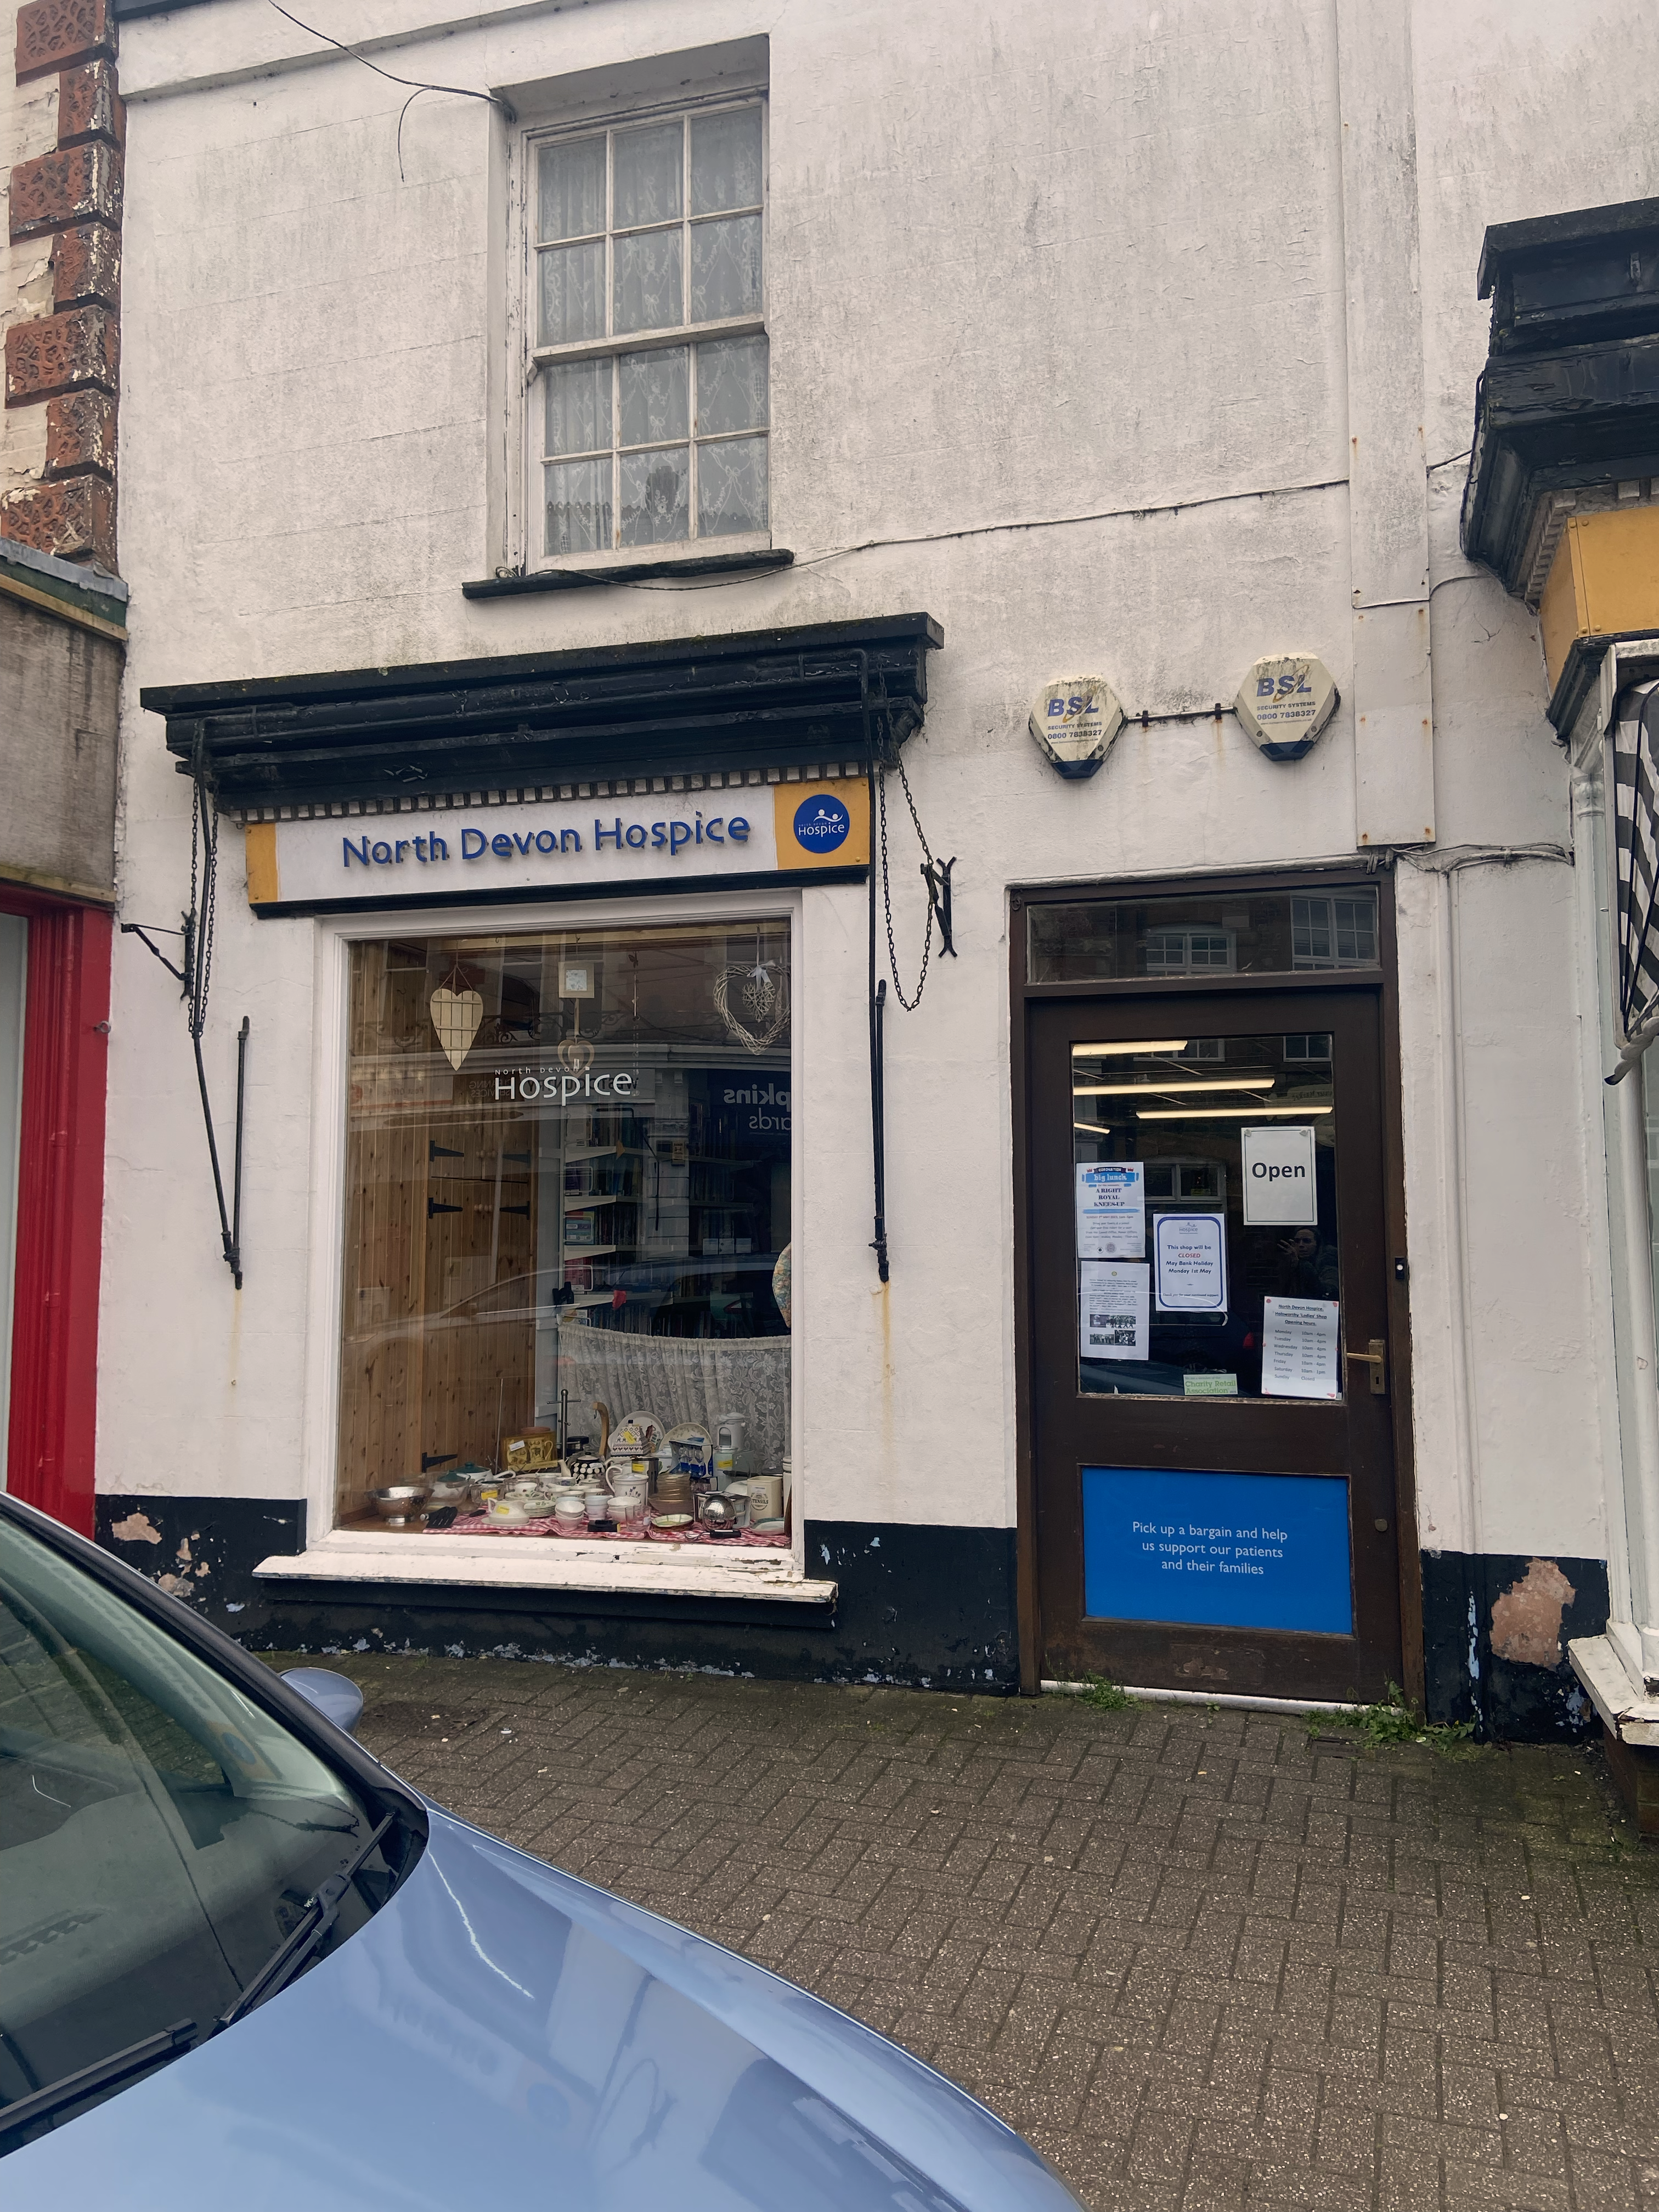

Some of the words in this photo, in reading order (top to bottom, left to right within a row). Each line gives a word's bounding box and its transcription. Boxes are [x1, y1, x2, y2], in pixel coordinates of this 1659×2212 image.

[1256, 674, 1312, 697] BSL
[1047, 695, 1099, 717] BSL
[1280, 710, 1316, 719] 7838327
[1069, 730, 1102, 738] 7838327
[343, 831, 449, 867] North
[461, 828, 580, 860] Devon
[595, 811, 751, 856] Hospice
[798, 822, 845, 838] Hospice
[495, 1066, 632, 1107] Hospice
[1252, 1162, 1305, 1182] Open
[1132, 1521, 1157, 1533] Pick
[1160, 1526, 1175, 1537] up
[1189, 1524, 1232, 1539] bargain
[1236, 1527, 1257, 1538] and
[1262, 1528, 1288, 1543] help
[1142, 1542, 1155, 1551] us
[1159, 1543, 1206, 1555] support
[1209, 1545, 1231, 1555] our
[1235, 1546, 1283, 1559] patients
[1161, 1559, 1183, 1570] and
[1186, 1560, 1216, 1572] their
[1219, 1561, 1264, 1575] families
